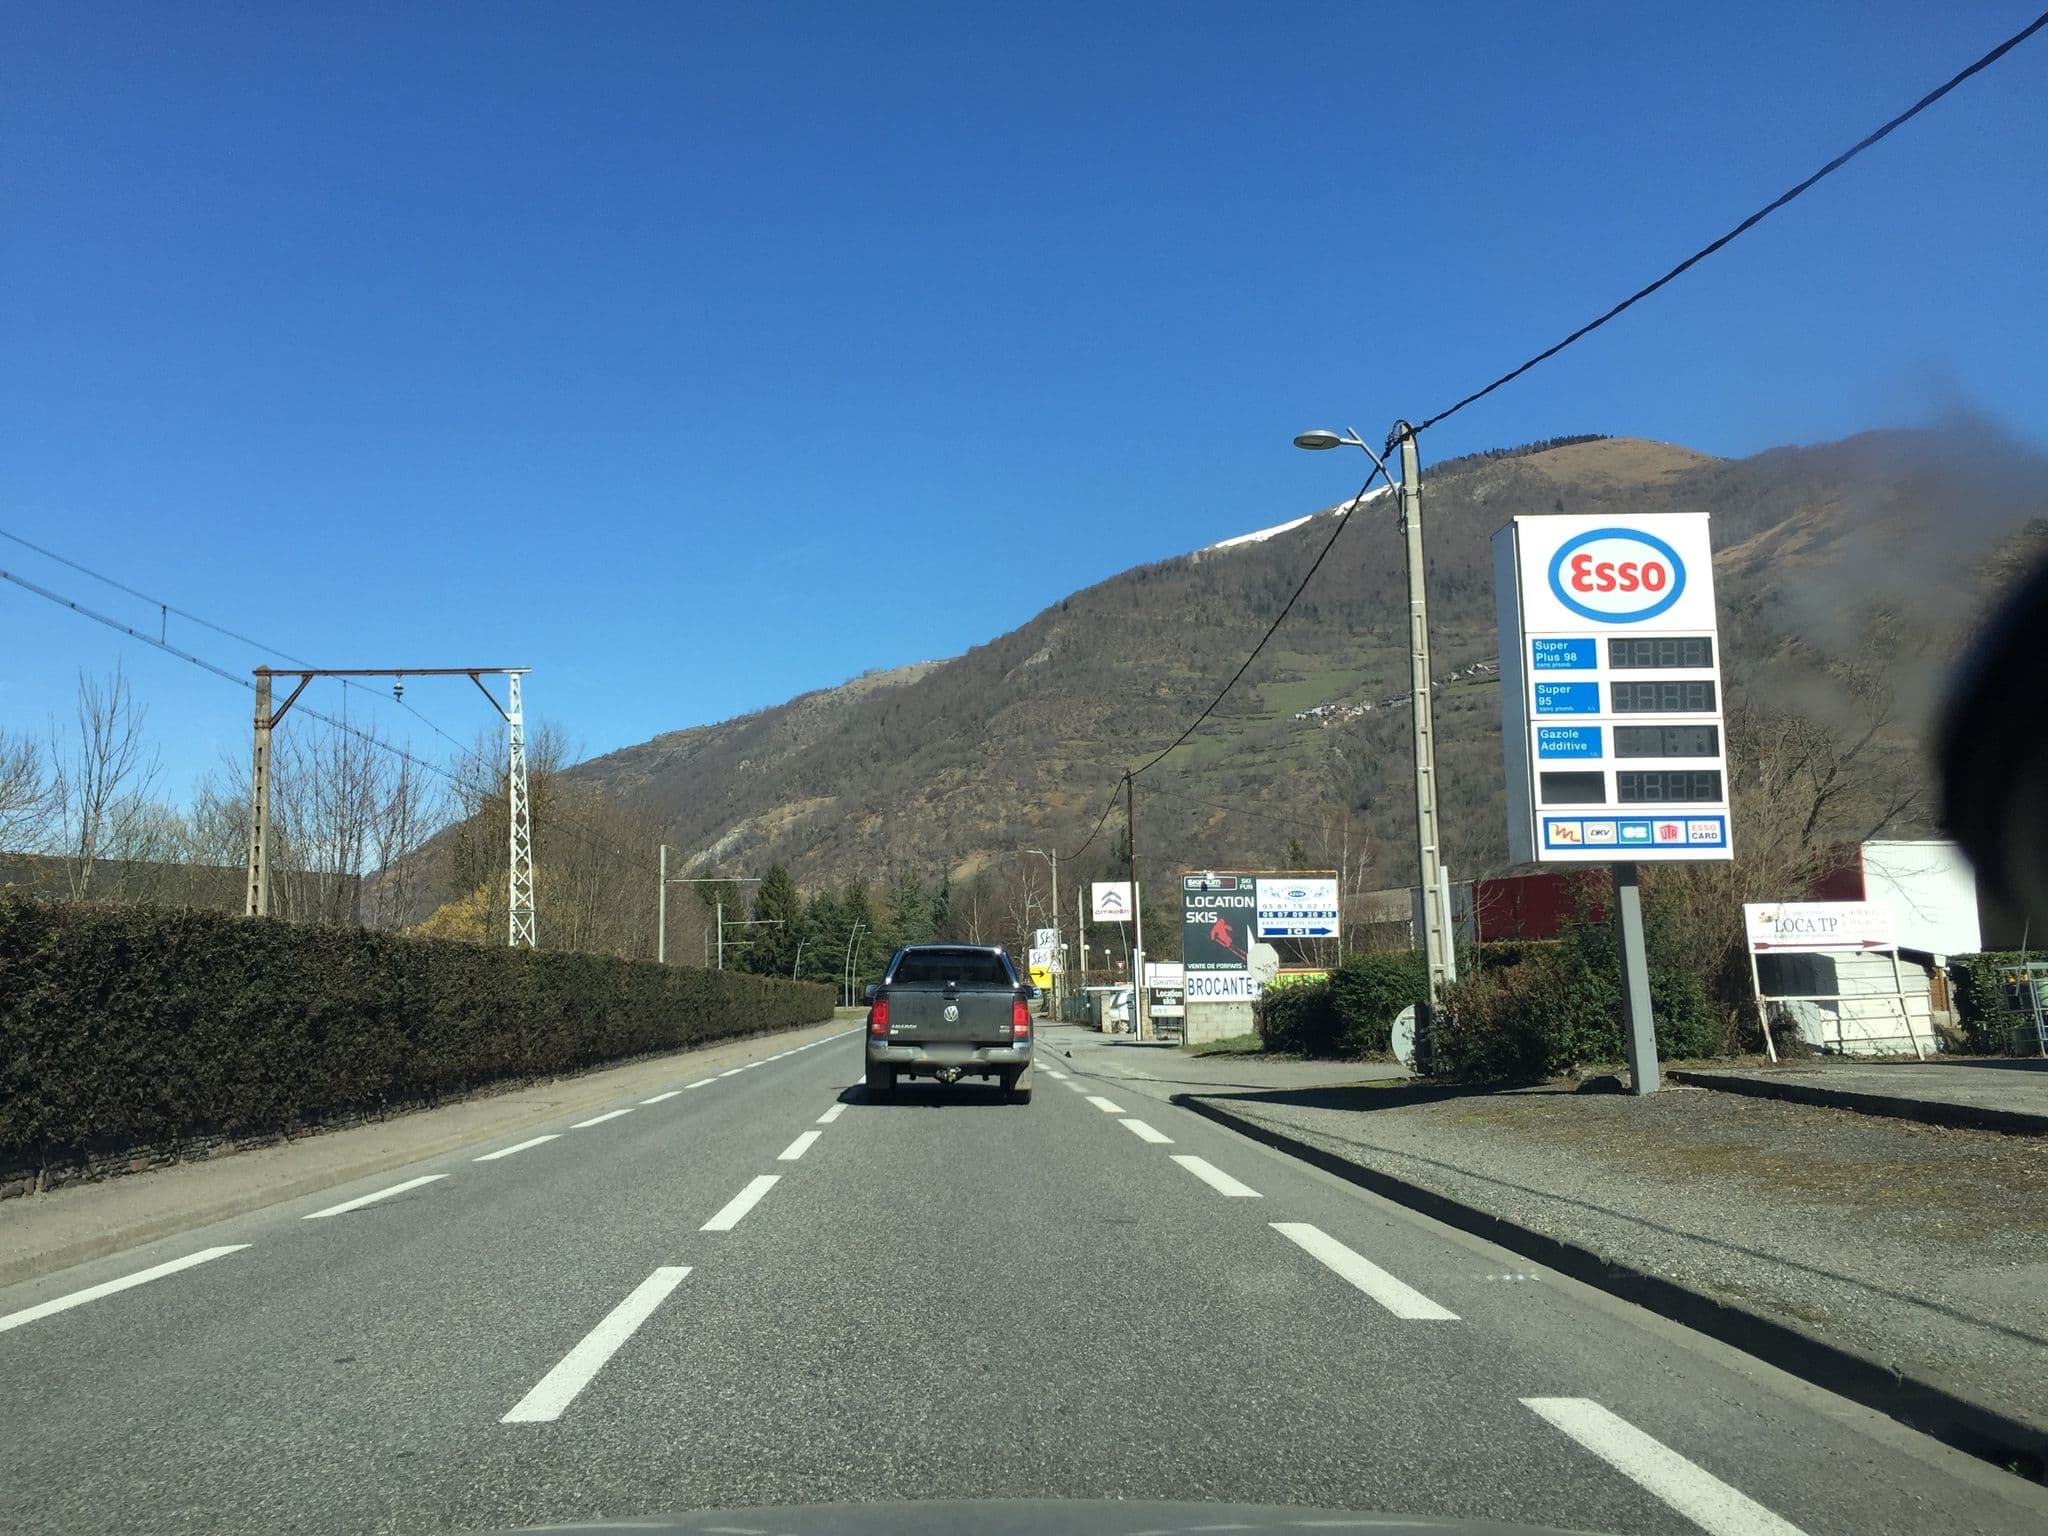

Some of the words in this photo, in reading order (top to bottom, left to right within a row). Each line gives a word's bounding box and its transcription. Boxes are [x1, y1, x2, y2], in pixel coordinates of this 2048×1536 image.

[1571, 554, 1665, 592] Esso
[1535, 641, 1568, 651] Super
[1536, 652, 1560, 661] Plus
[1563, 652, 1577, 661] 98
[1538, 685, 1571, 695] Super
[1539, 697, 1552, 705] 95
[1540, 729, 1579, 738] Gazole
[1541, 742, 1587, 751] Additive
[1691, 824, 1717, 832] ESSO
[1590, 829, 1610, 837] DKV
[1691, 832, 1718, 840] CARD
[1185, 896, 1255, 908] LOCATION
[1186, 911, 1218, 923] SKIS
[1775, 917, 1816, 933] LOCA
[1818, 917, 1838, 932] TP
[1188, 977, 1253, 996] BROCANTE
